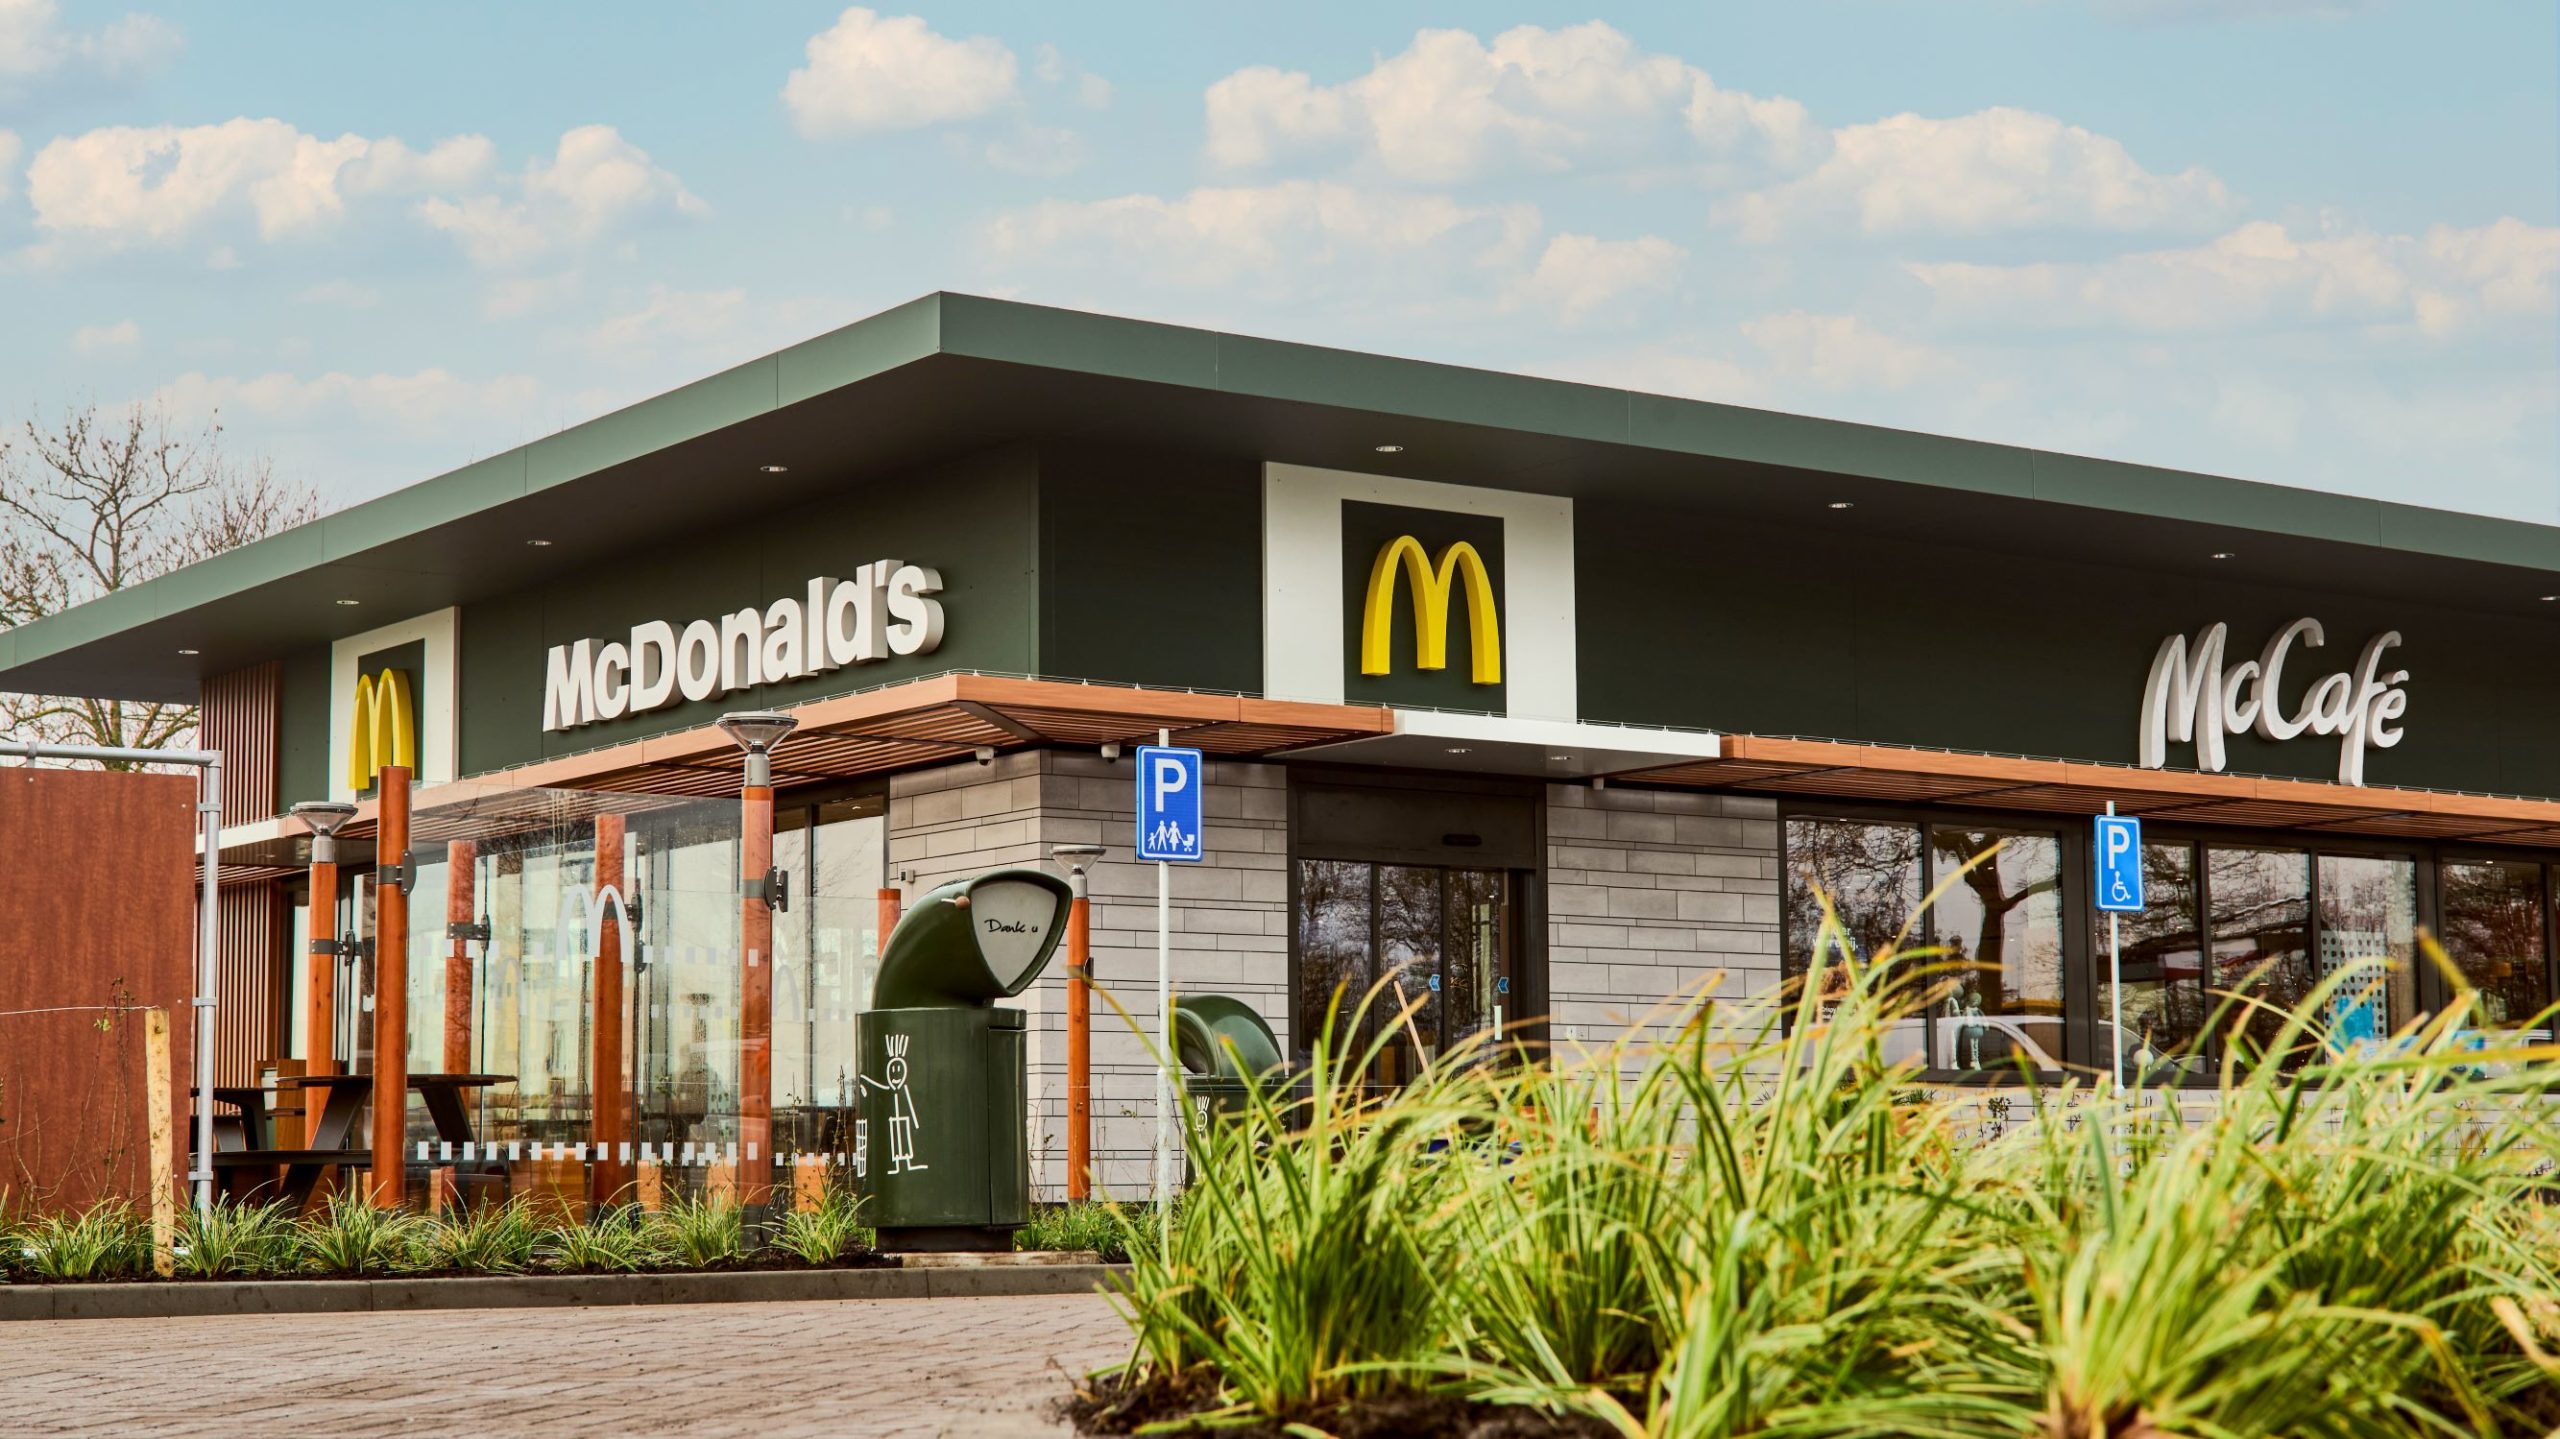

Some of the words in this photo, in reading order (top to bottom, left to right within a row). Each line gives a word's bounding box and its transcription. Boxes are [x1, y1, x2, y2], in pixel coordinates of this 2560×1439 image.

[542, 559, 945, 732] McDonald's
[2139, 617, 2409, 787] McCafé
[1155, 757, 1188, 813] P
[2107, 824, 2131, 870] P
[984, 918, 1026, 933] Dank
